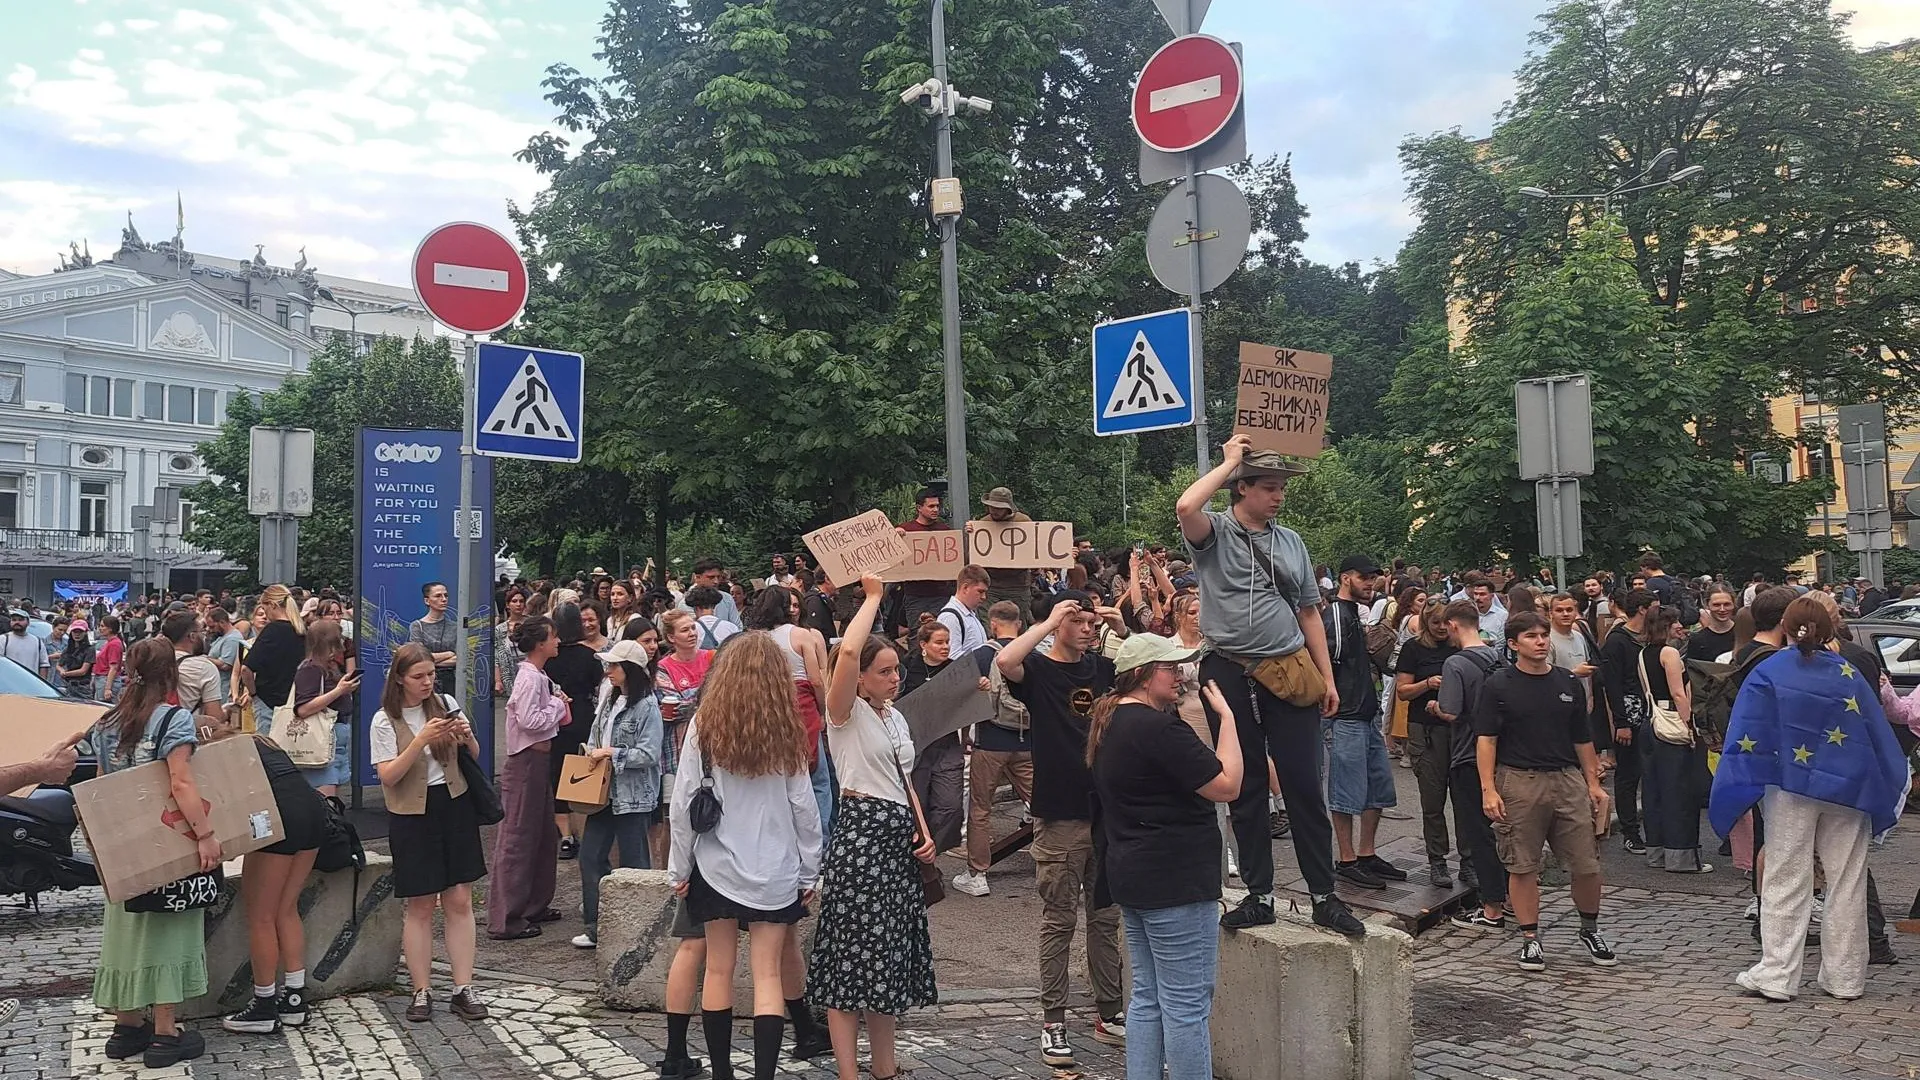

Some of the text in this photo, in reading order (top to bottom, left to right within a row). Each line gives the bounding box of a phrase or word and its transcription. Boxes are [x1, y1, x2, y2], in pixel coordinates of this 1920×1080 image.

[1274, 350, 1298, 369] ЯК
[1241, 368, 1328, 396] ДЕМОКРАТІЯ
[1258, 391, 1323, 417] ЗНИКЛА
[379, 447, 436, 460] KYIV
[375, 467, 389, 477] IS
[374, 483, 436, 493] WAITING
[374, 498, 439, 509] FOR YOU
[374, 513, 422, 524] AFTER
[374, 529, 404, 539] THE
[973, 522, 1071, 562] ОФІС
[373, 544, 442, 555] VICTORY!
[900, 535, 959, 566] БАВ
[164, 887, 218, 912] ЗВУКУ
